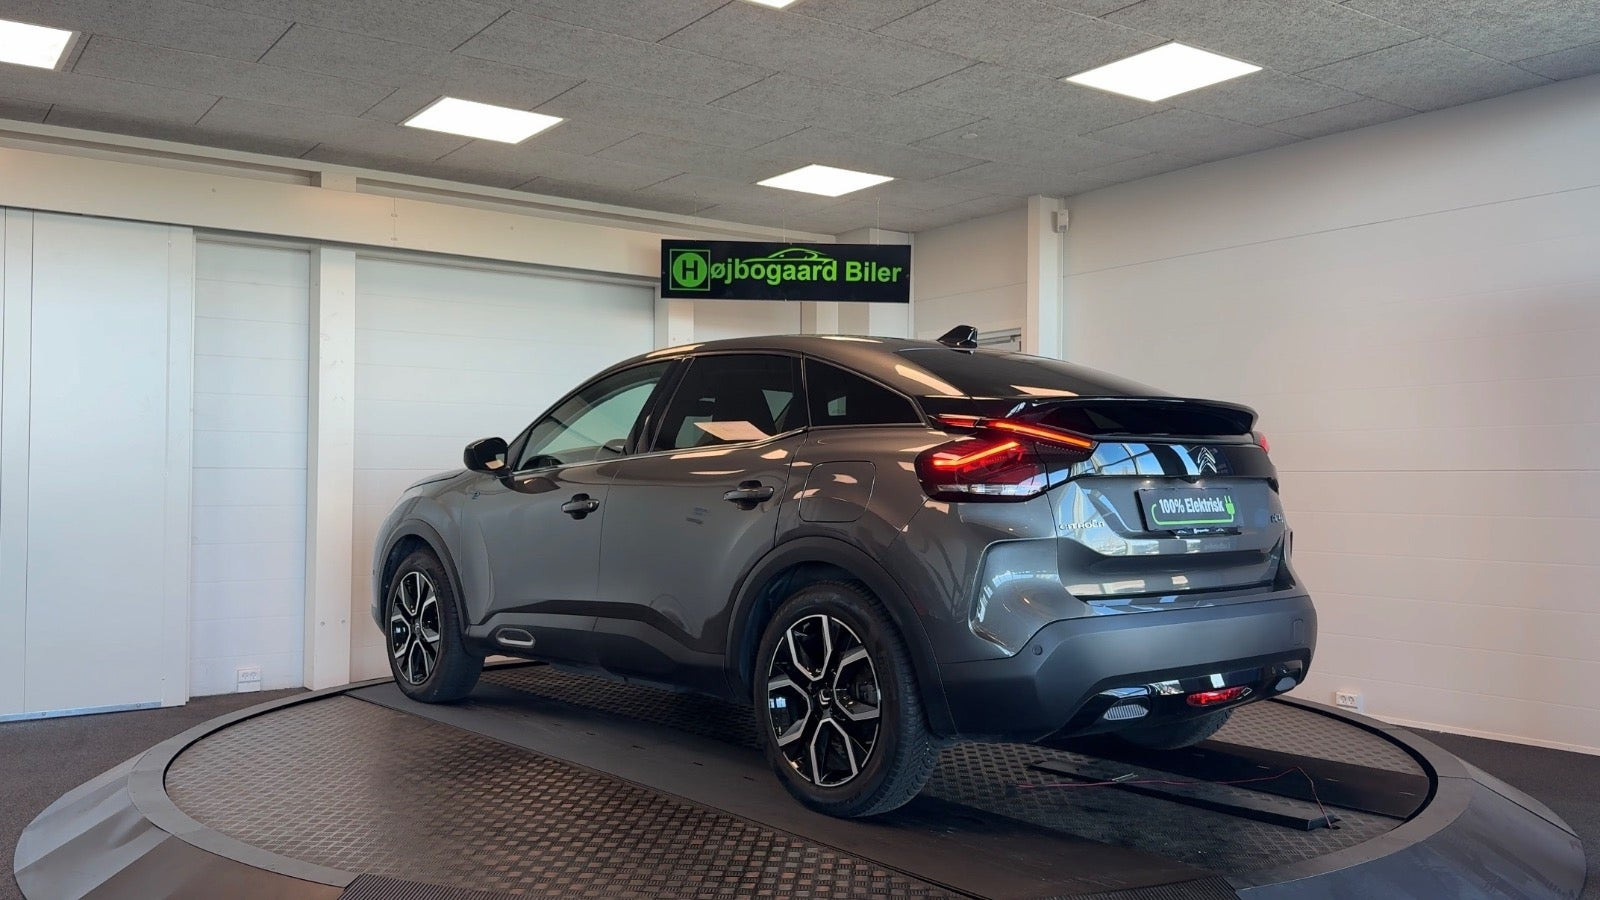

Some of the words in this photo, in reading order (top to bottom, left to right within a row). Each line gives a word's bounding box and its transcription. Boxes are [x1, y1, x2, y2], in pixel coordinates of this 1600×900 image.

[845, 261, 902, 283] Biler
[1159, 498, 1185, 513] 100%
[1184, 497, 1225, 513] Elektrisk
